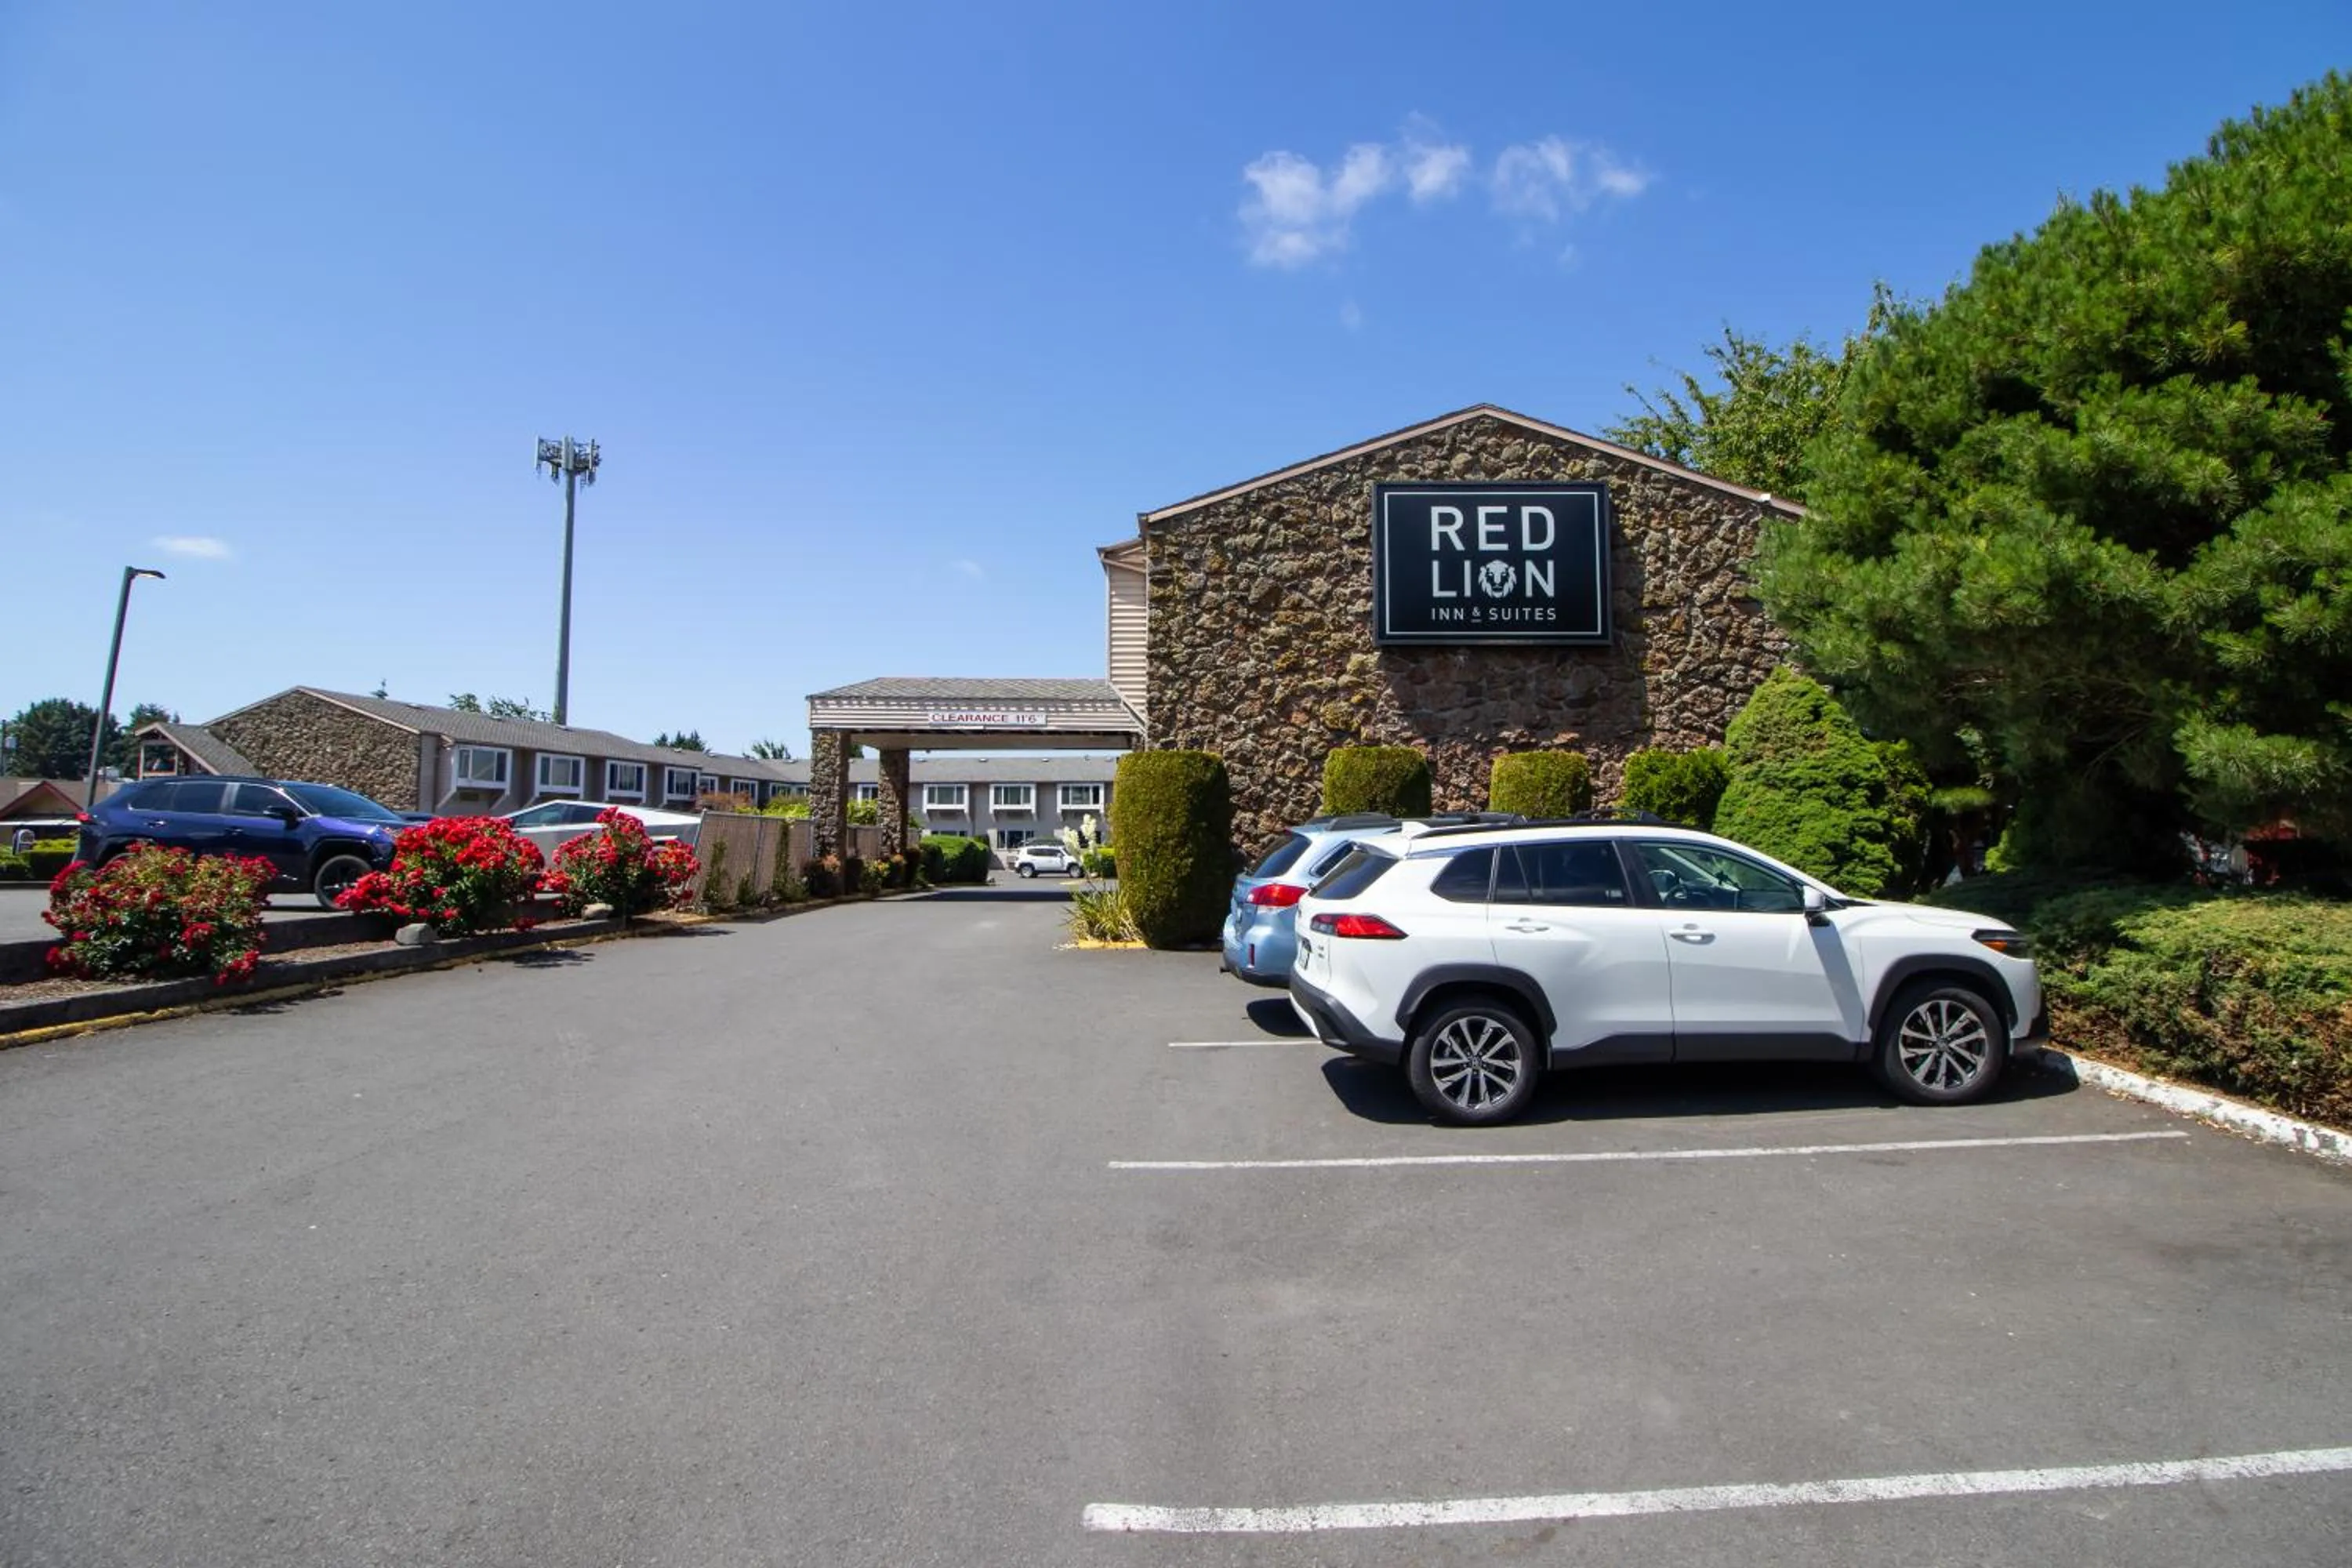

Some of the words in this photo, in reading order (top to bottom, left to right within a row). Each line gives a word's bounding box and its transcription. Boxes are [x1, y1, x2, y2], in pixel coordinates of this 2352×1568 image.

[1431, 506, 1555, 551] RED
[1431, 608, 1465, 621] INN
[1471, 606, 1481, 617] &
[1489, 608, 1556, 621] SUITES
[932, 714, 1008, 723] CLEARANCE
